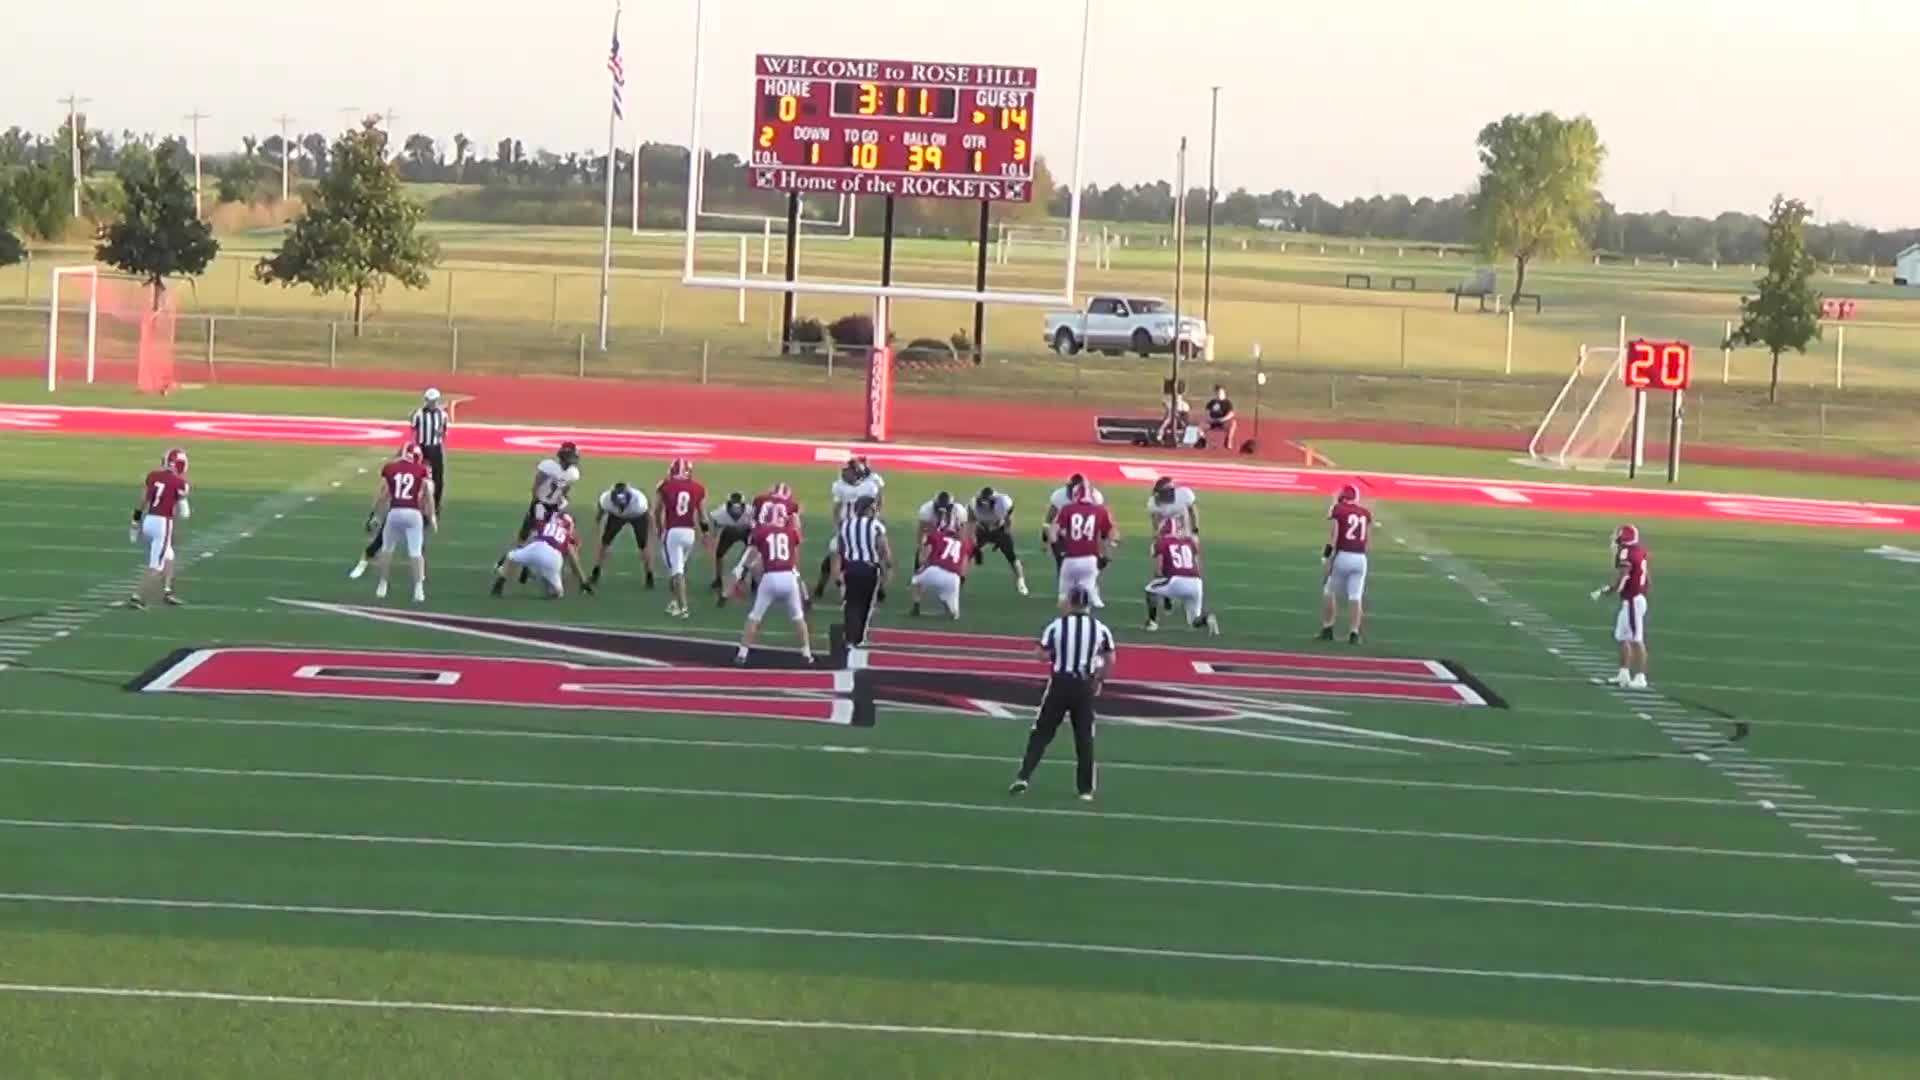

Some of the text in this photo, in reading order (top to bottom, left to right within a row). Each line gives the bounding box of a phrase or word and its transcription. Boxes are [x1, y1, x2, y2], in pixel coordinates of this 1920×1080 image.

[763, 56, 1031, 86] WELCOME to ROSE HILL
[764, 79, 811, 98] HOME
[975, 89, 1028, 108] GUEST
[779, 95, 797, 122] 0
[1001, 107, 1027, 131] 14
[759, 125, 775, 148] 2
[793, 126, 830, 141] DOWN
[843, 129, 879, 144] TO GO
[903, 131, 947, 147] BALL ON
[962, 134, 987, 149] QTR
[811, 142, 820, 165] 1
[851, 143, 878, 169] 10
[907, 145, 943, 172] 39
[973, 150, 983, 173] 1
[1012, 138, 1026, 161] 3
[779, 170, 1002, 199] Home of the ROCKETS
[1630, 343, 1686, 386] 20
[152, 480, 166, 508] 7
[393, 471, 416, 500] 12
[1070, 512, 1097, 541] 84
[1345, 513, 1367, 542] 21
[940, 536, 962, 564] 74
